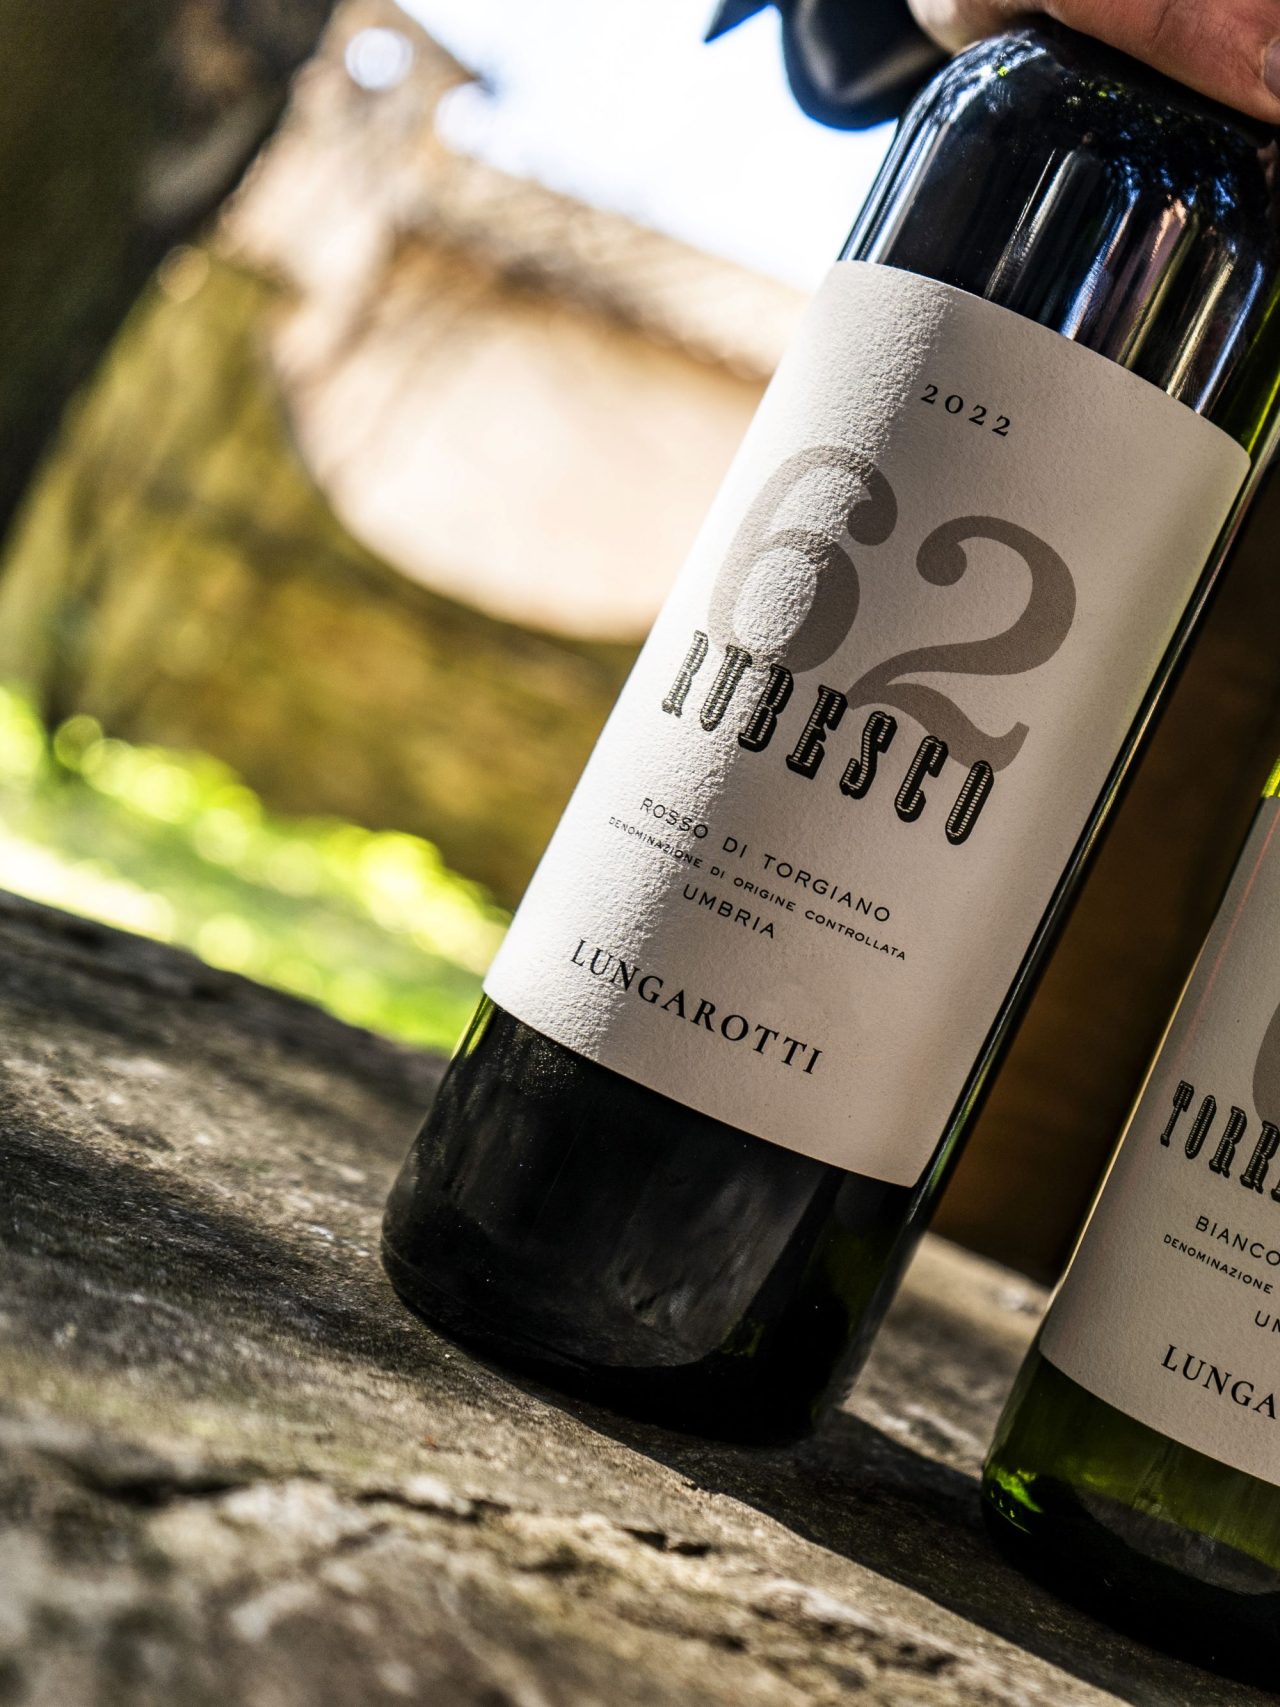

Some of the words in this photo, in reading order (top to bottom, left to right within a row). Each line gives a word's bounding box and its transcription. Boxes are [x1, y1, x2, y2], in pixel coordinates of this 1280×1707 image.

[920, 383, 1012, 437] 2022
[707, 445, 1077, 770] 62
[662, 630, 995, 845] RUBESCO
[608, 816, 702, 869] DENOMINAZIONE
[709, 864, 727, 879] DI
[733, 875, 795, 913] ORIGINE
[805, 908, 906, 961] CONTROLLATA
[640, 796, 709, 840] ROSSO
[723, 837, 748, 857] DI
[762, 853, 892, 922] TORGIANO
[682, 884, 776, 940] UMBRIA
[569, 938, 824, 1076] LUNGAROTTI
[1163, 1234, 1273, 1295] DENOMINAZIONE
